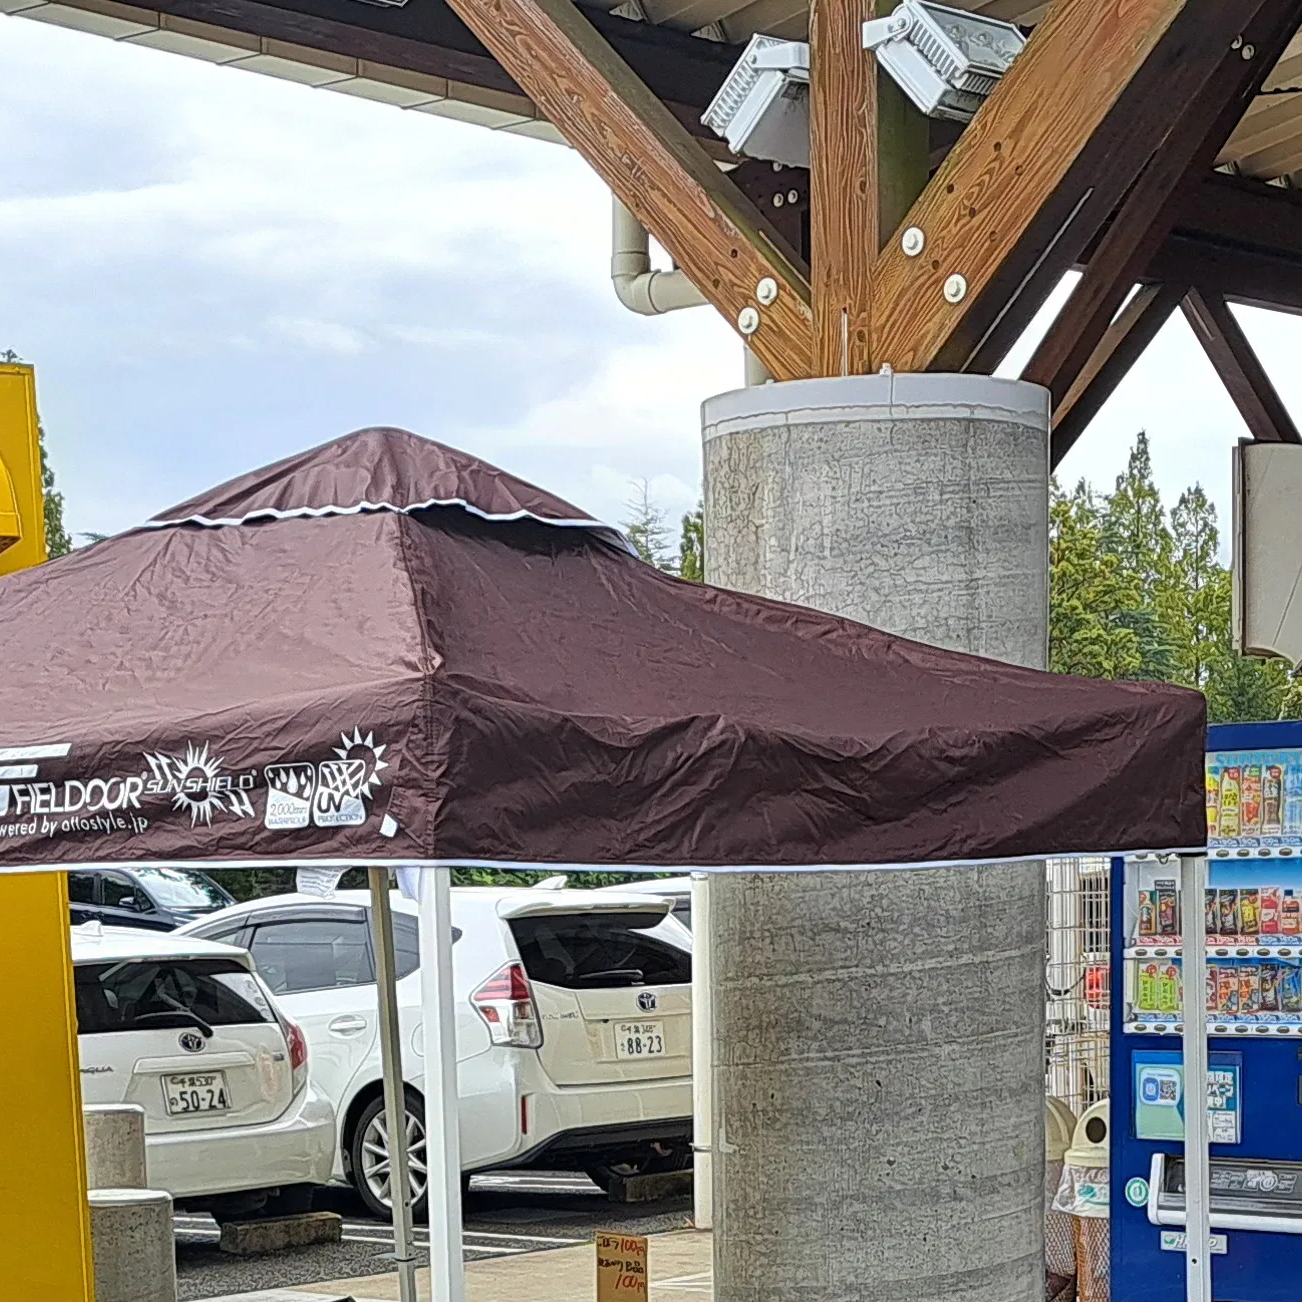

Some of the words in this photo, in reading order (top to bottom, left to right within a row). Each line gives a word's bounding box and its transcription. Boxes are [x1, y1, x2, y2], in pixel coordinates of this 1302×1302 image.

[143, 772, 255, 796] SUNSHIELD
[11, 776, 142, 817] FIELDOOR
[40, 814, 58, 838] by
[627, 1036, 663, 1055] 88-23
[179, 1088, 227, 1112] 50-24
[615, 1274, 646, 1293] 100円
